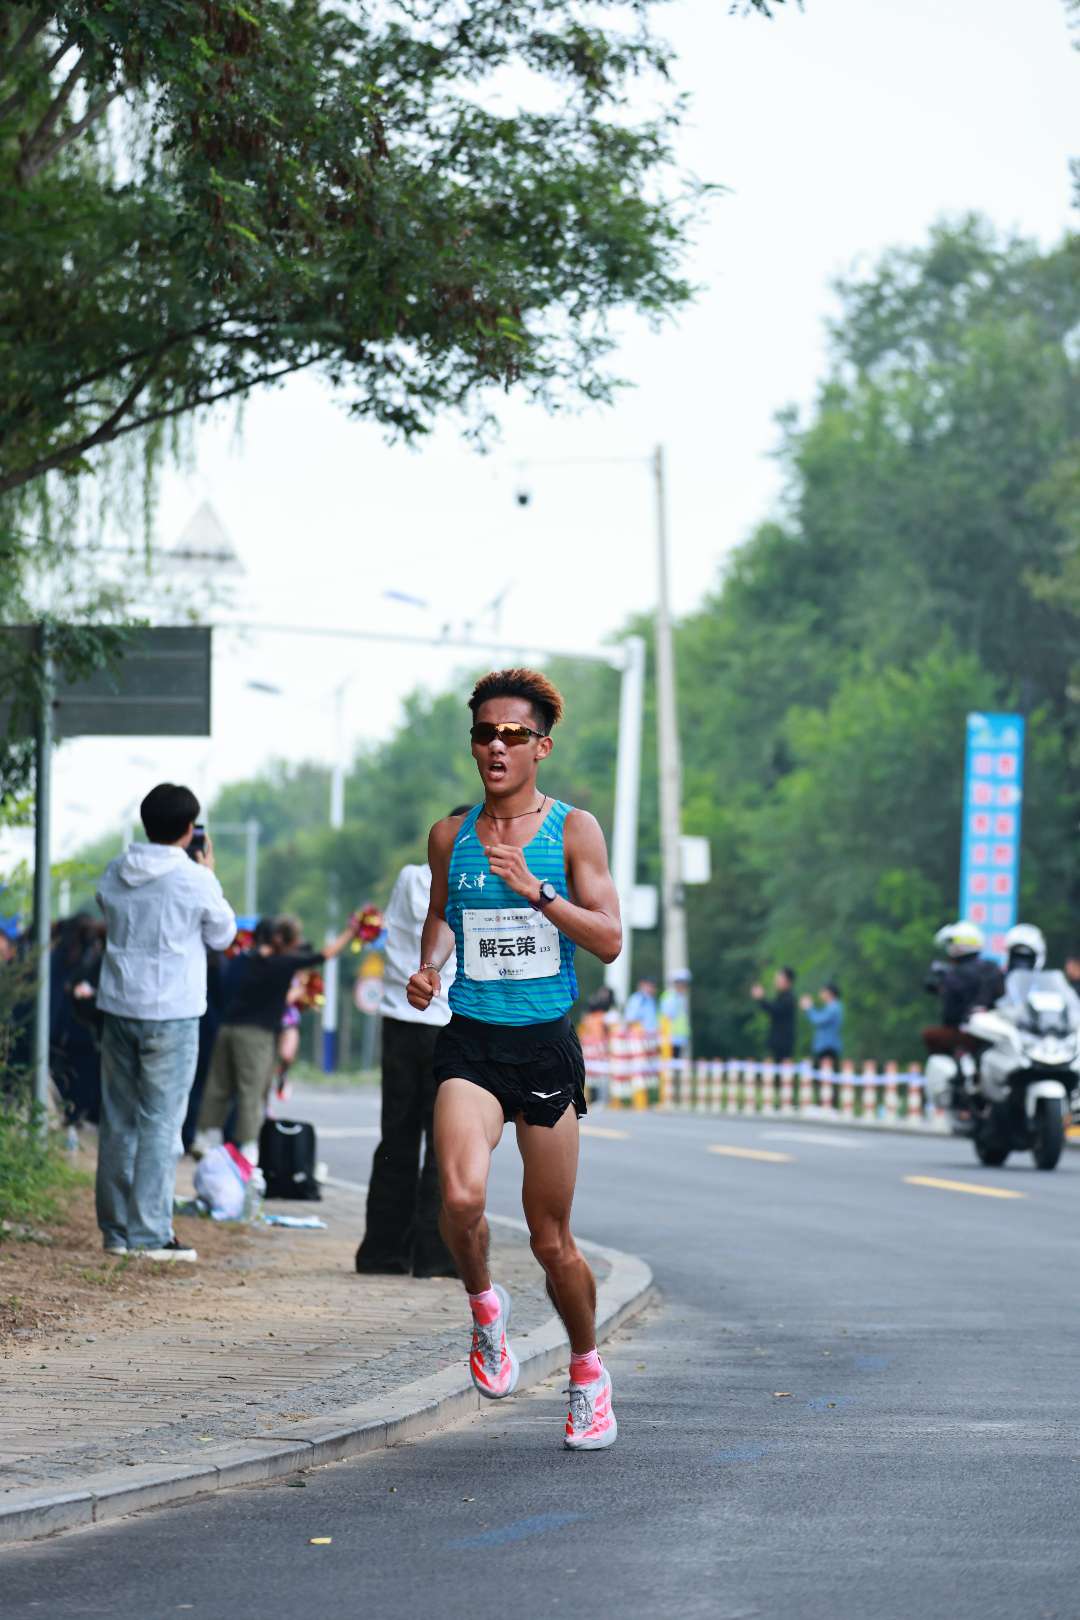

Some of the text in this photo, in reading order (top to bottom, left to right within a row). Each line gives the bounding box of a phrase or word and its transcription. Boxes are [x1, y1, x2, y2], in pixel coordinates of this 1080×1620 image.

[458, 871, 487, 893] 天津
[479, 936, 536, 958] 解云策
